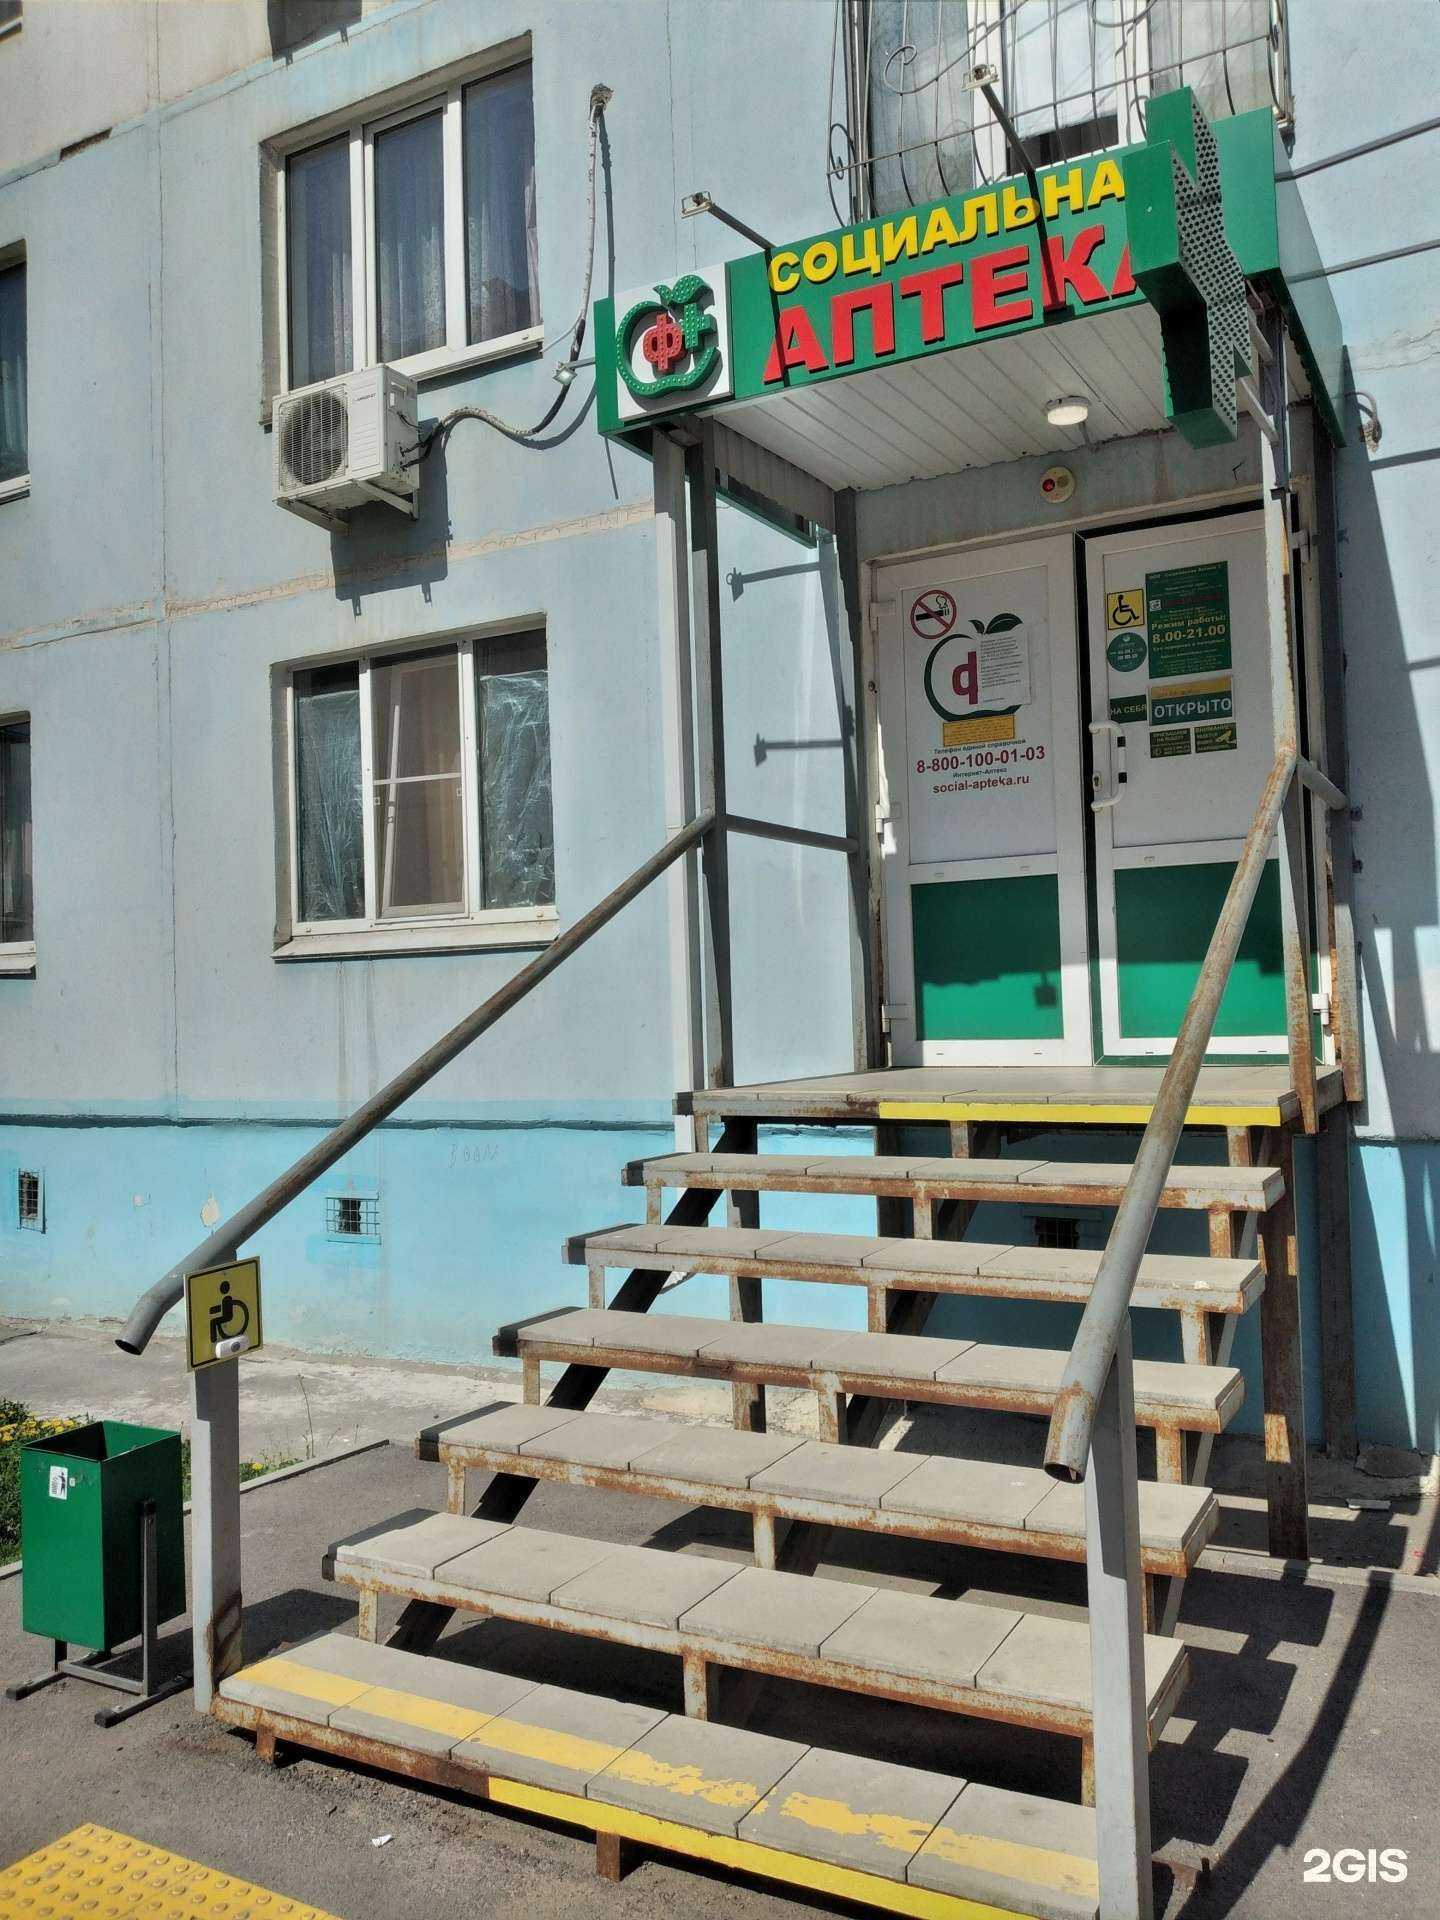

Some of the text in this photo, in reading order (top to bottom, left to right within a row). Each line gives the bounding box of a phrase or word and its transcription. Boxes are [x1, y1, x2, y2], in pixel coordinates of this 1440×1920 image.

[770, 160, 1126, 294] СОЦИАЛЬНА
[1151, 619, 1186, 632] Режим
[1154, 697, 1232, 719] ОТКРЫТО
[916, 745, 1046, 774] 8-800-100-01-03
[932, 775, 1030, 794] social-apteka.ru
